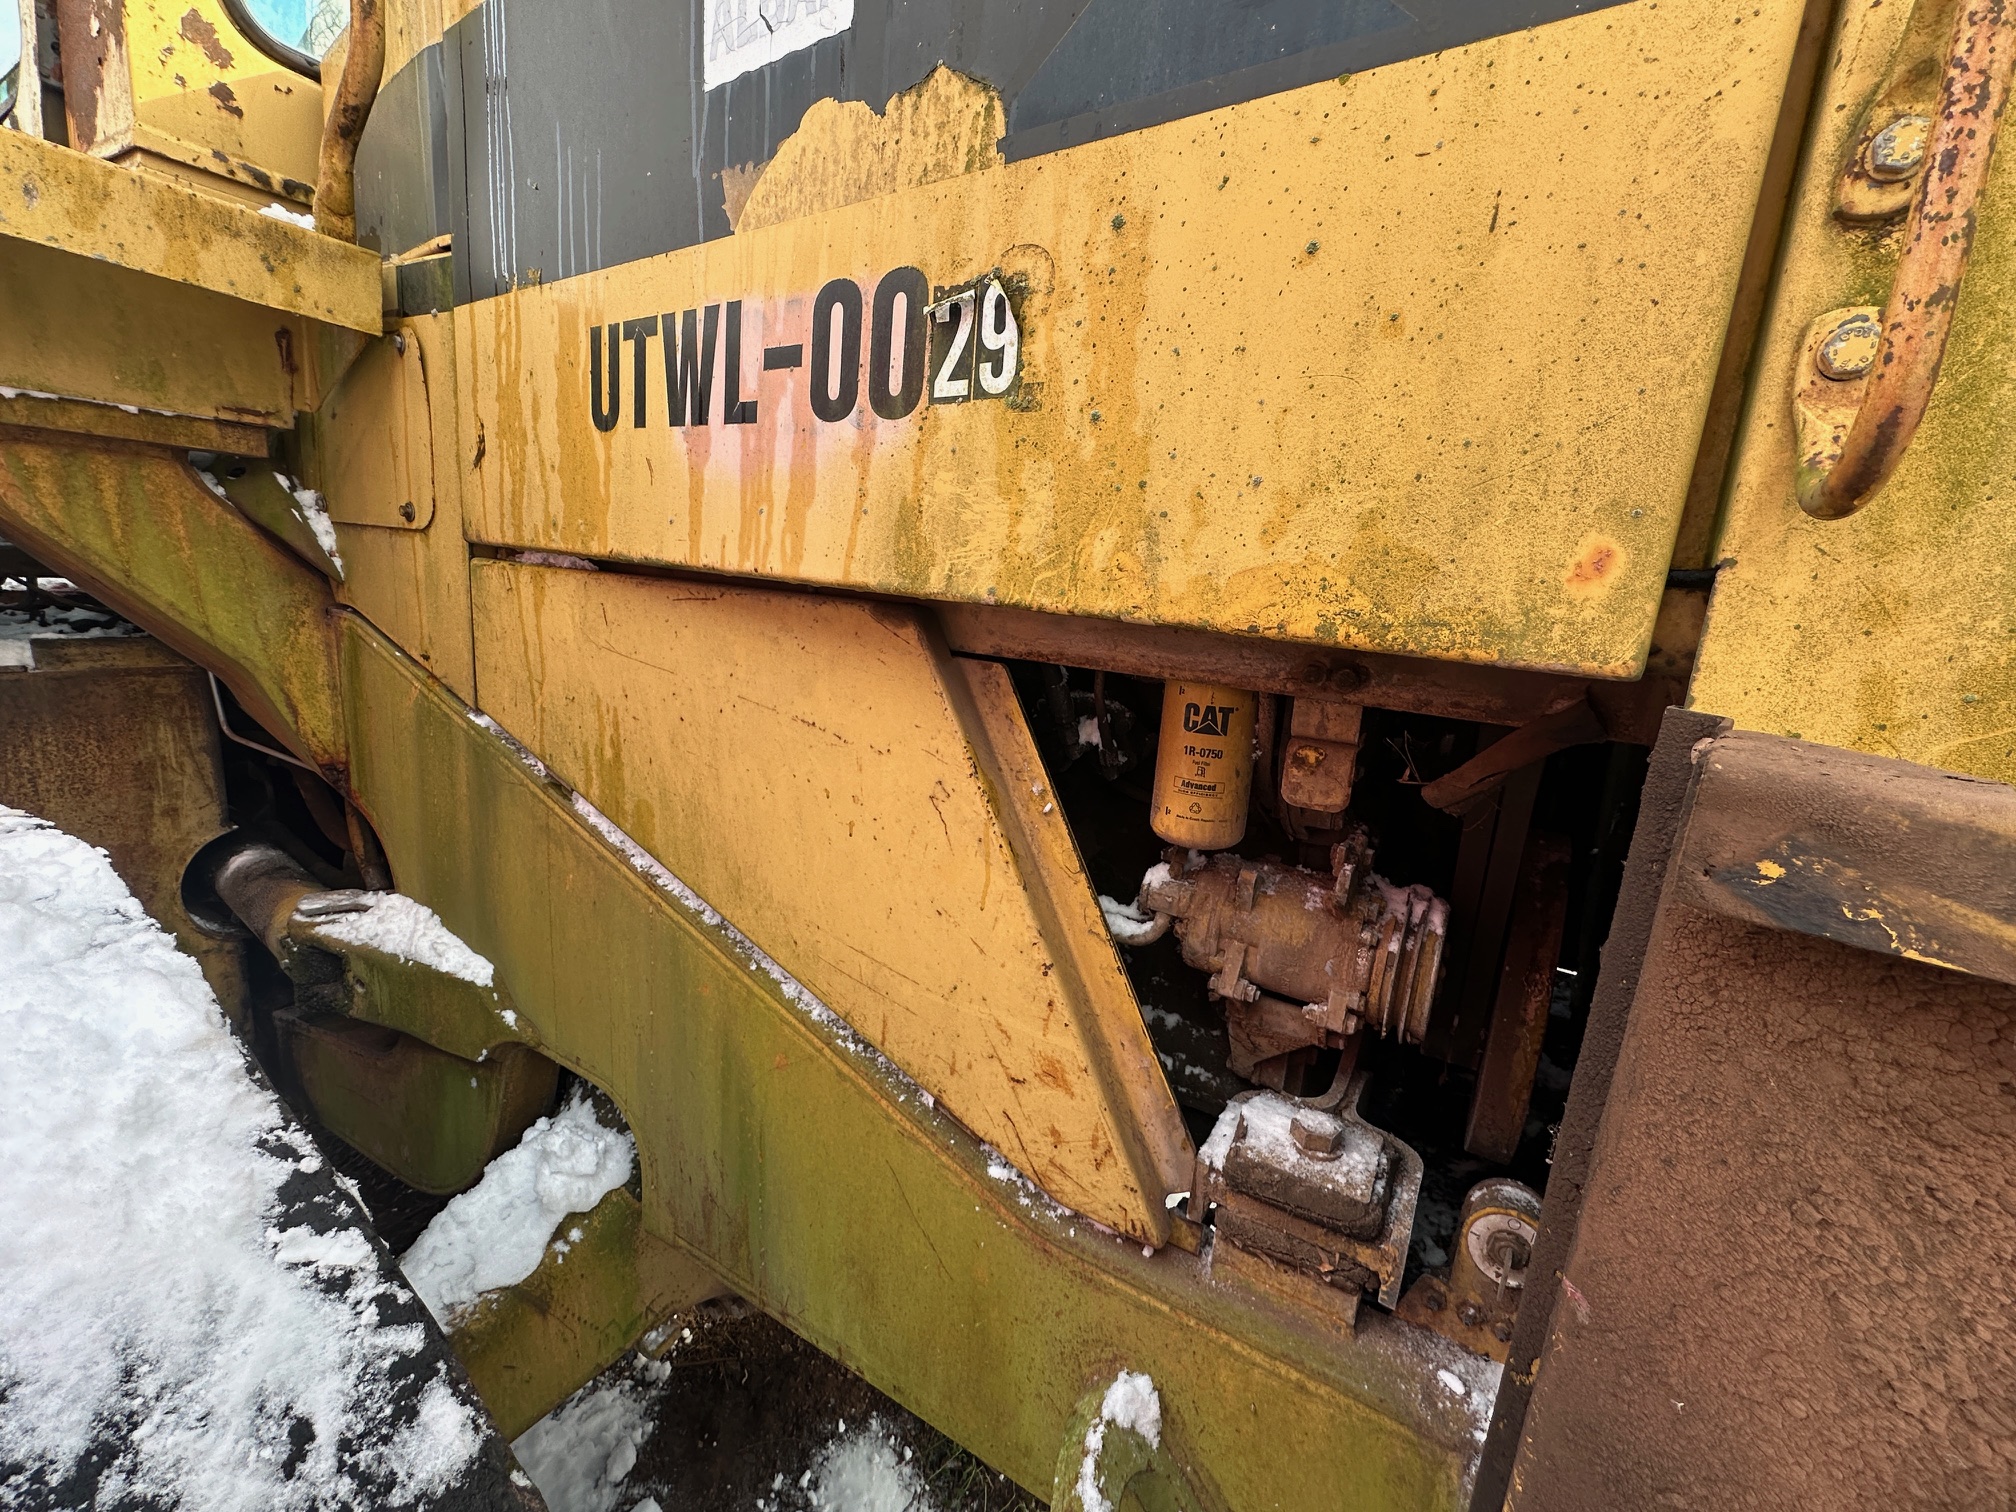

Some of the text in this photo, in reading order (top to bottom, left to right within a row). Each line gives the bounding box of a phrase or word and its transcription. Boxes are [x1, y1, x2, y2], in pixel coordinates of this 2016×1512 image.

[590, 266, 1020, 432] UTWL-0029
[1183, 702, 1234, 736] CAT
[1184, 745, 1223, 759] 1R-0750
[1181, 779, 1217, 791] Advanced
